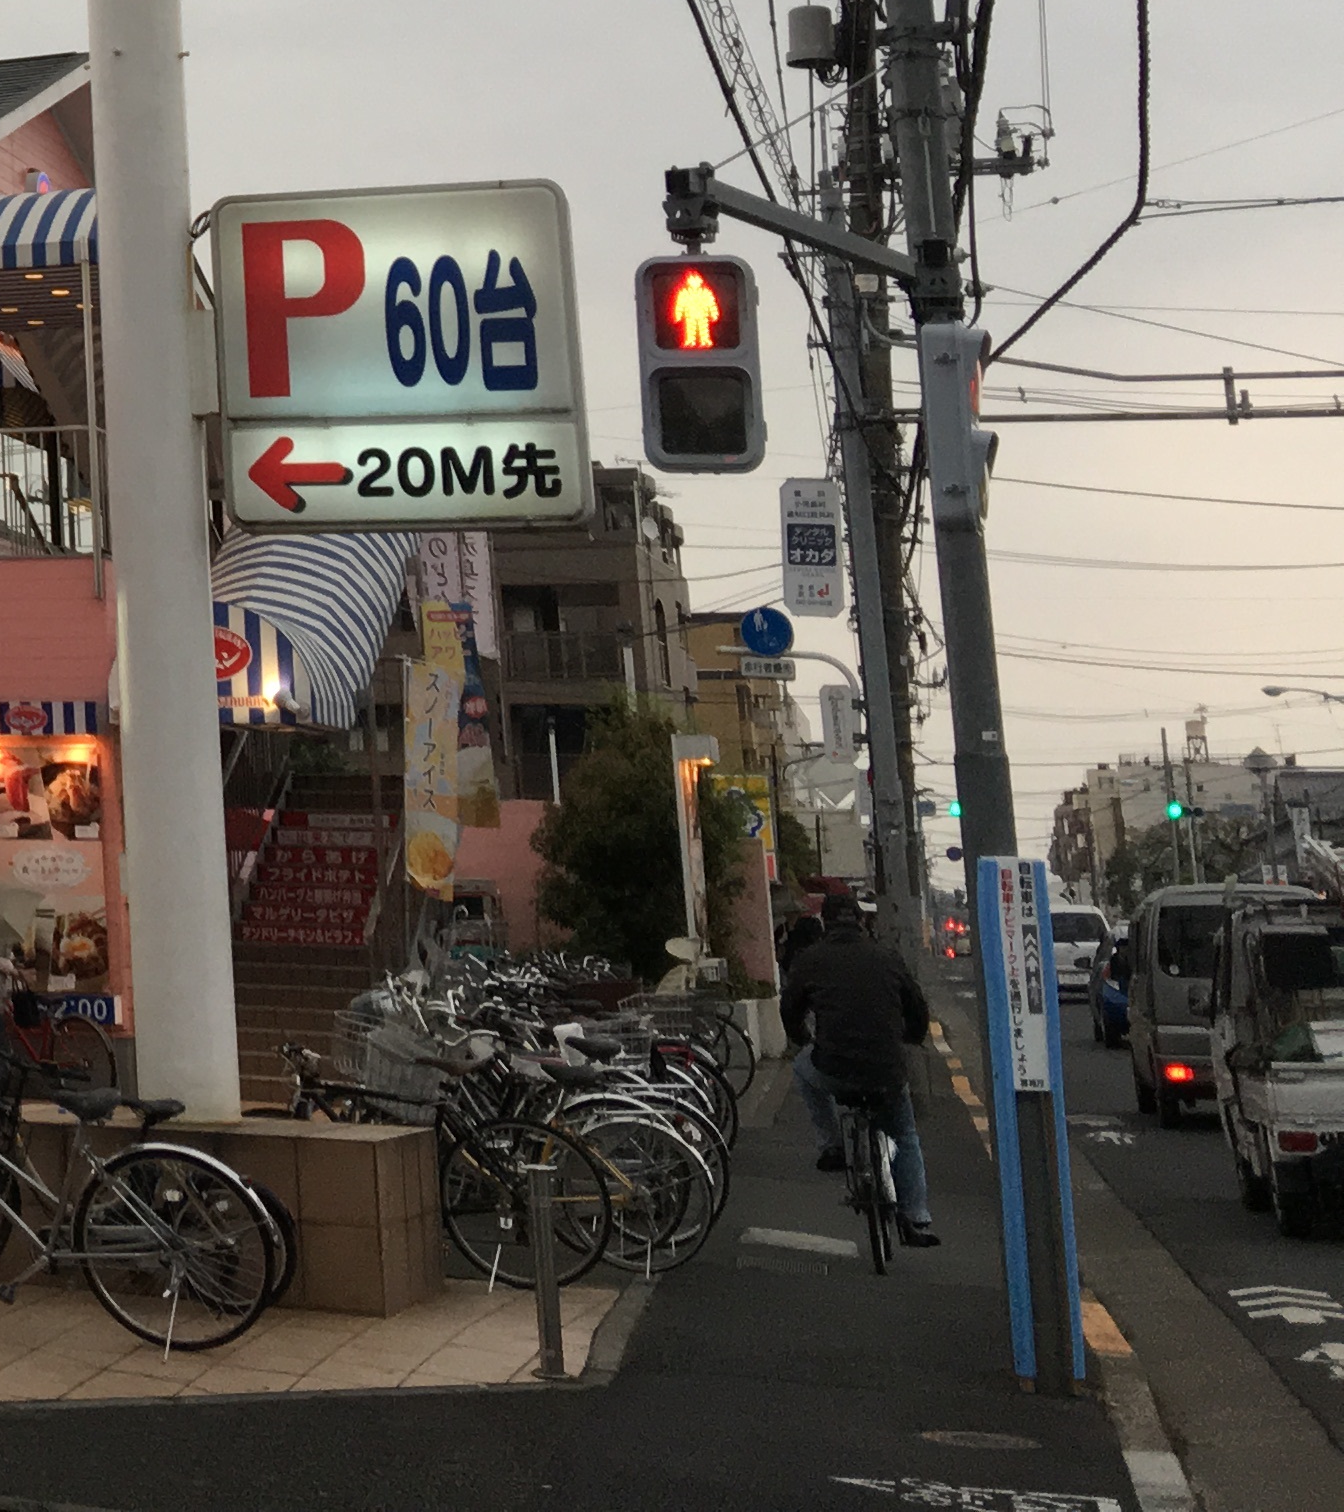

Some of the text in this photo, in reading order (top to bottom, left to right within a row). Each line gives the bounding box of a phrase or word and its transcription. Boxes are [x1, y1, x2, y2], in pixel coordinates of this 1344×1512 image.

[241, 218, 366, 399] P
[384, 249, 539, 392] 60台
[356, 442, 563, 500] 20M先
[790, 548, 835, 564] オカダ
